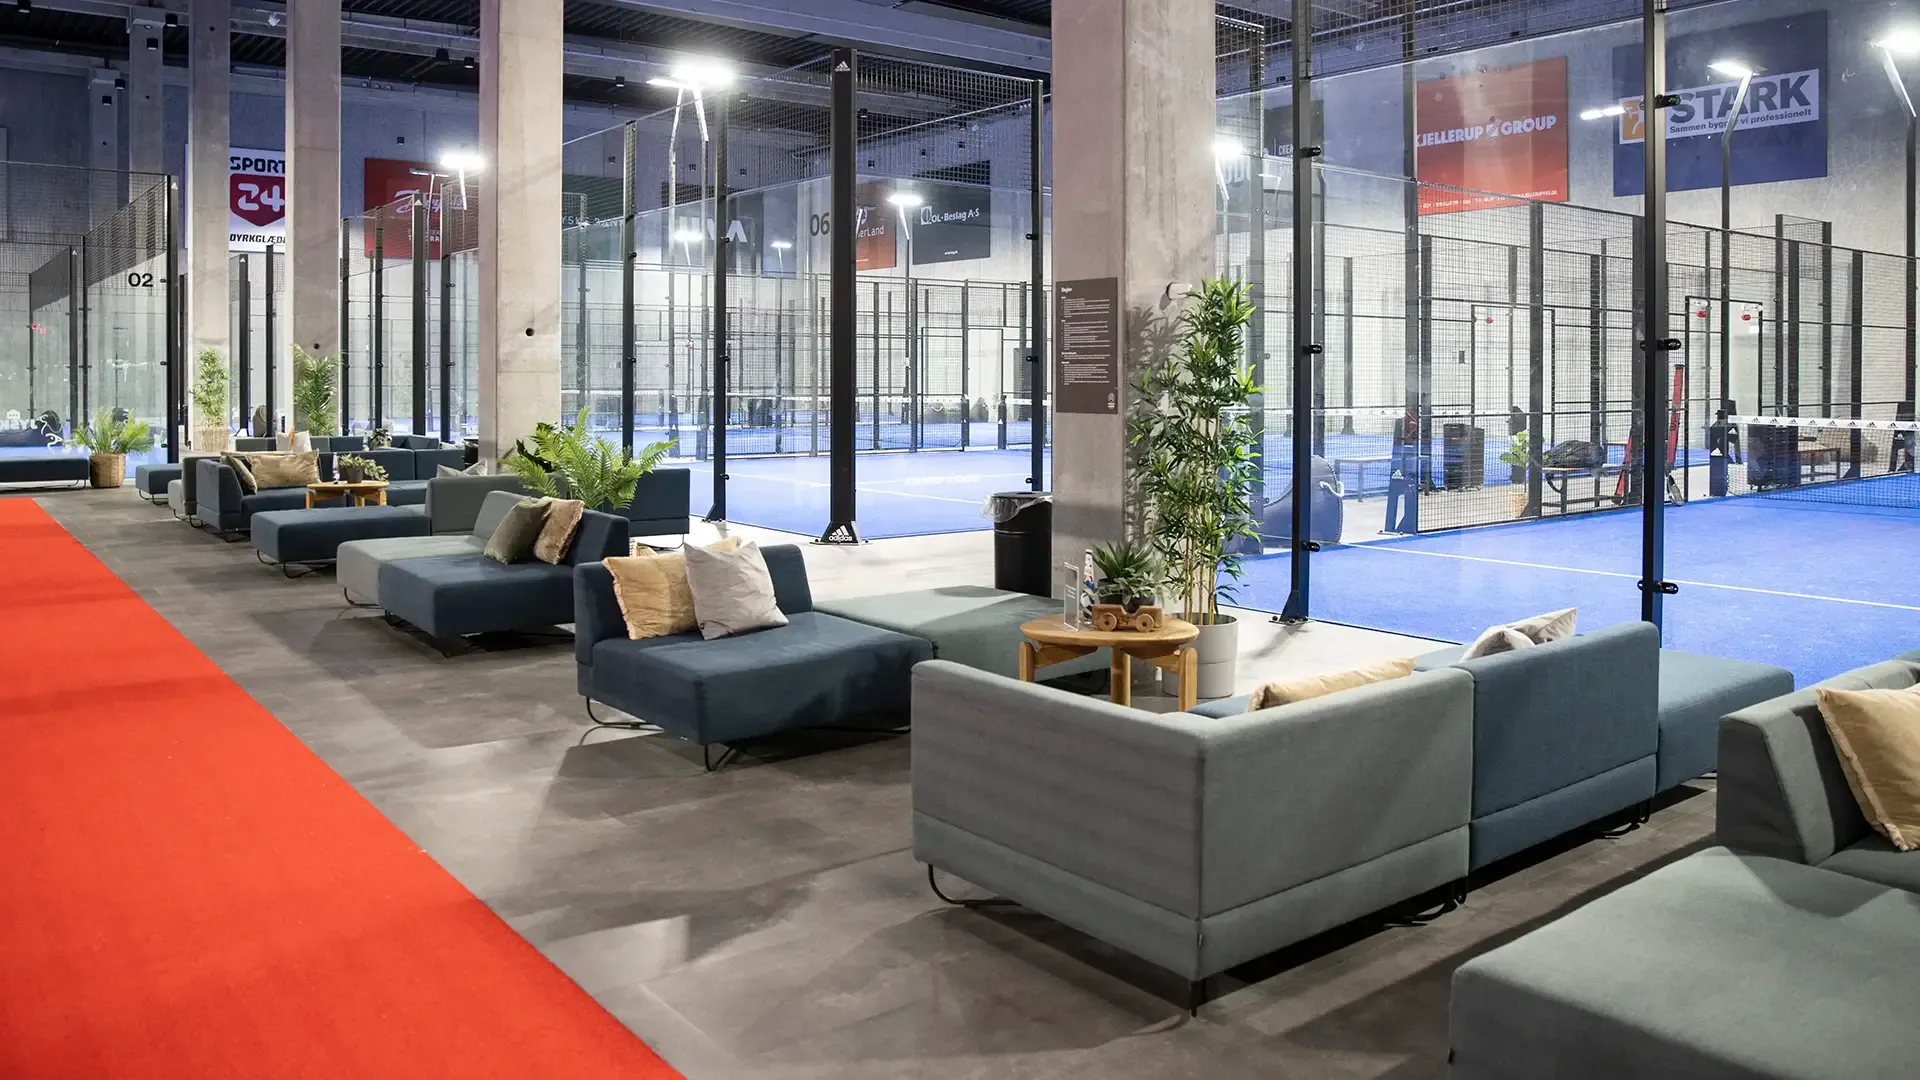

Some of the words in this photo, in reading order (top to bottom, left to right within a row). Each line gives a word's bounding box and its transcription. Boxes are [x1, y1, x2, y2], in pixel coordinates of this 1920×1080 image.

[1670, 74, 1811, 123] STARK
[1416, 125, 1484, 148] KJELLERUP
[1501, 115, 1557, 135] GROUP
[1670, 124, 1706, 134] Sammen
[1741, 116, 1749, 125] vi
[1750, 109, 1812, 125] professionelt
[229, 156, 285, 174] SPORT
[238, 183, 285, 213] 24
[809, 212, 830, 237] 06
[858, 225, 885, 238] erLand
[128, 272, 153, 288] 02
[829, 533, 852, 542] adidas
